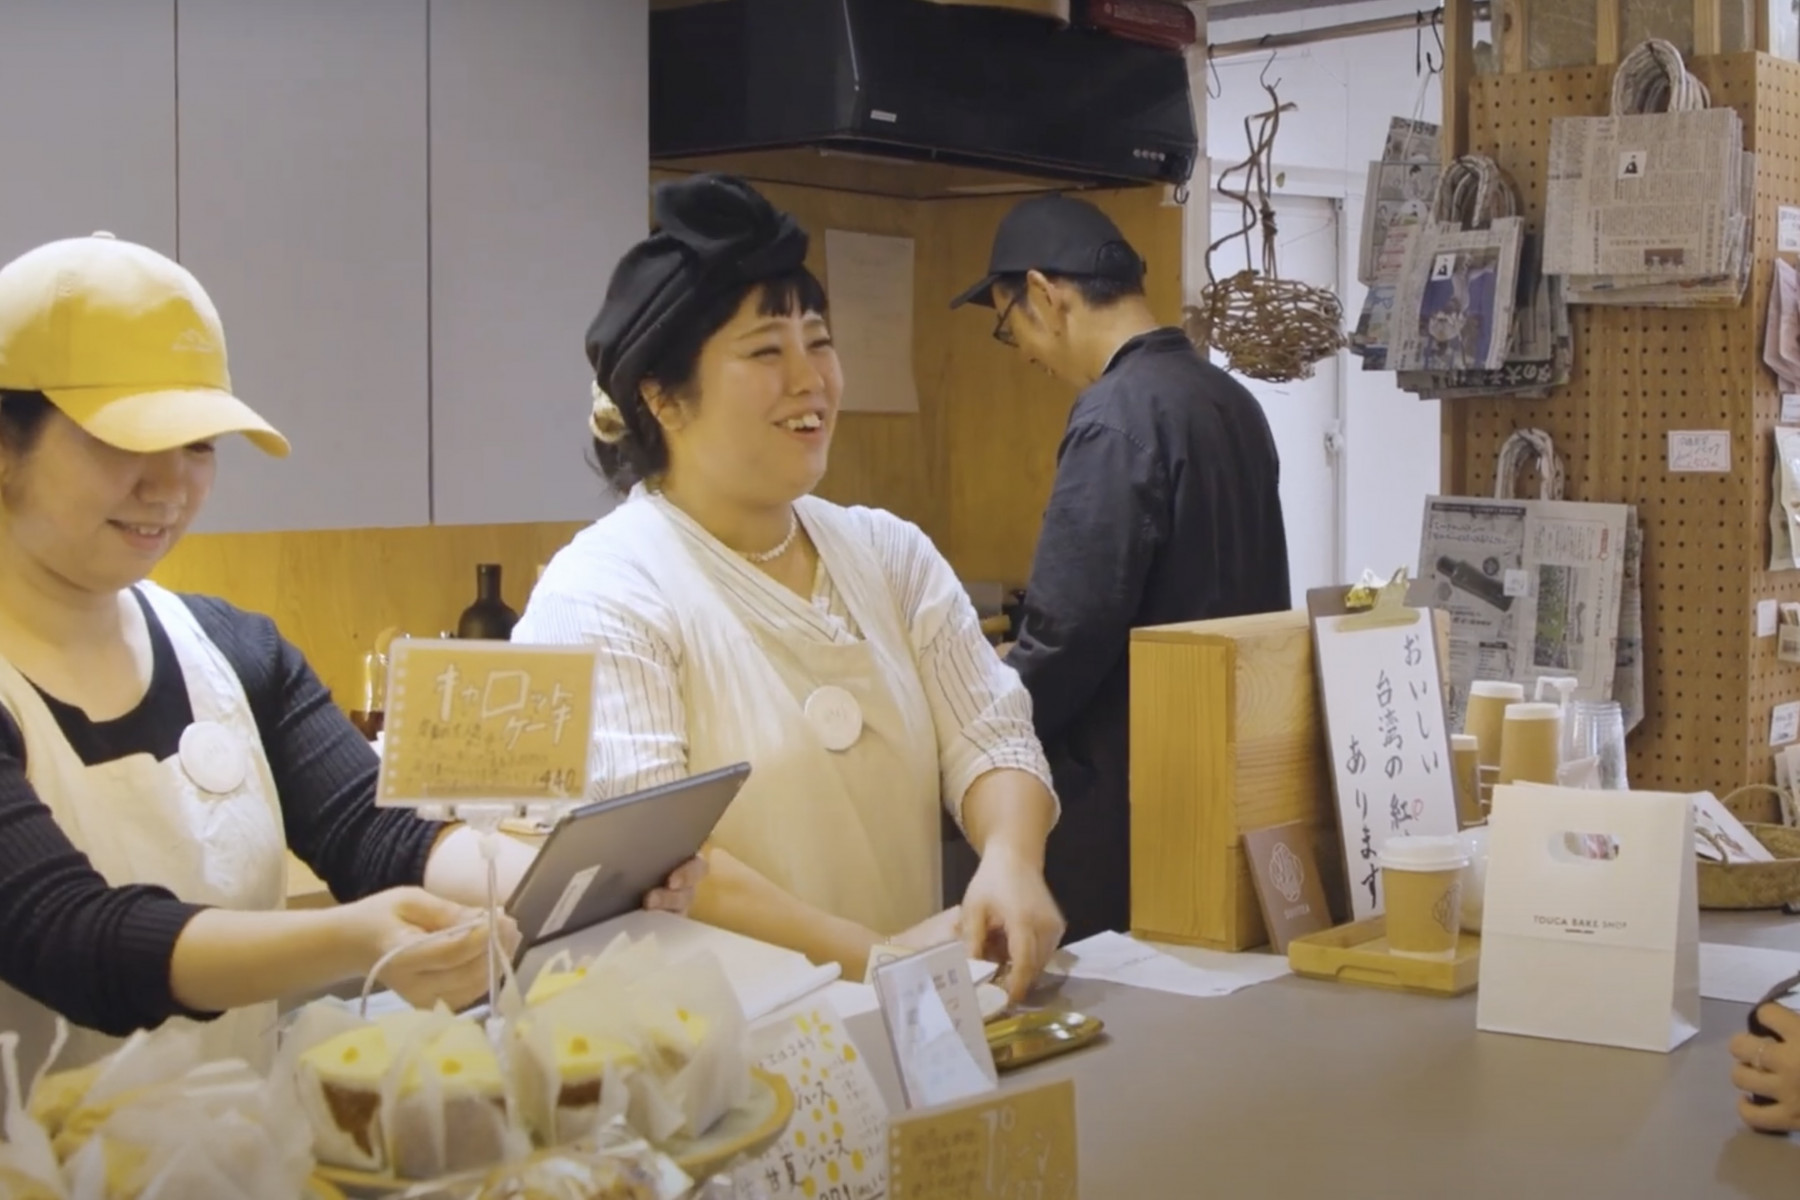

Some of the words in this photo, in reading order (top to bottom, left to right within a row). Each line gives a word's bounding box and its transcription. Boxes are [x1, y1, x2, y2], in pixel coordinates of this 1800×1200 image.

[435, 663, 573, 722] キャロット
[502, 704, 571, 750] ケーキ
[1403, 634, 1439, 775] おいしい
[1375, 670, 1413, 837] 台湾の紅
[1346, 735, 1382, 911] あります
[1533, 915, 1568, 926] TOUCA
[1571, 917, 1599, 928] BAKE
[1602, 920, 1627, 930] SHOP
